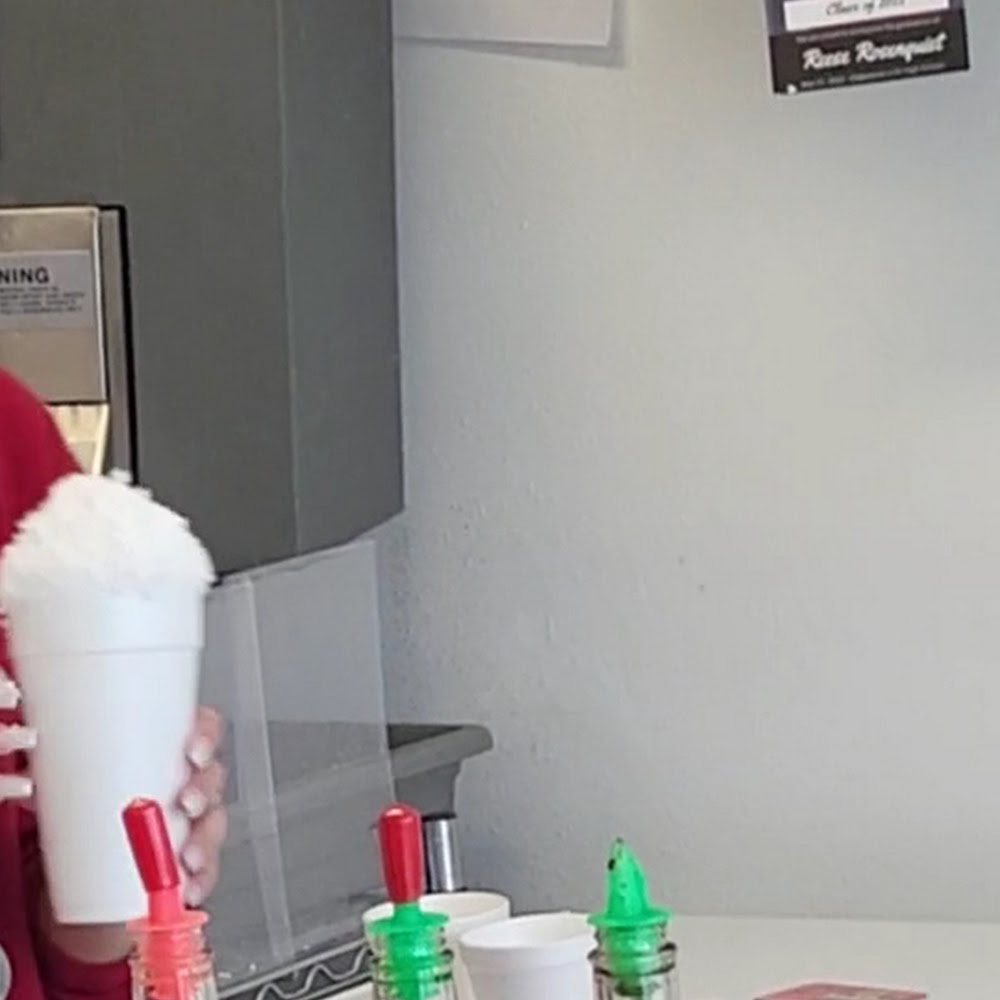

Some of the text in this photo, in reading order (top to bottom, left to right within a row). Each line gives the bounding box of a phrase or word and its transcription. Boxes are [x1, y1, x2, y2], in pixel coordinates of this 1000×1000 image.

[826, 0, 859, 16] Class
[803, 32, 947, 70] Reese Rosenquist
